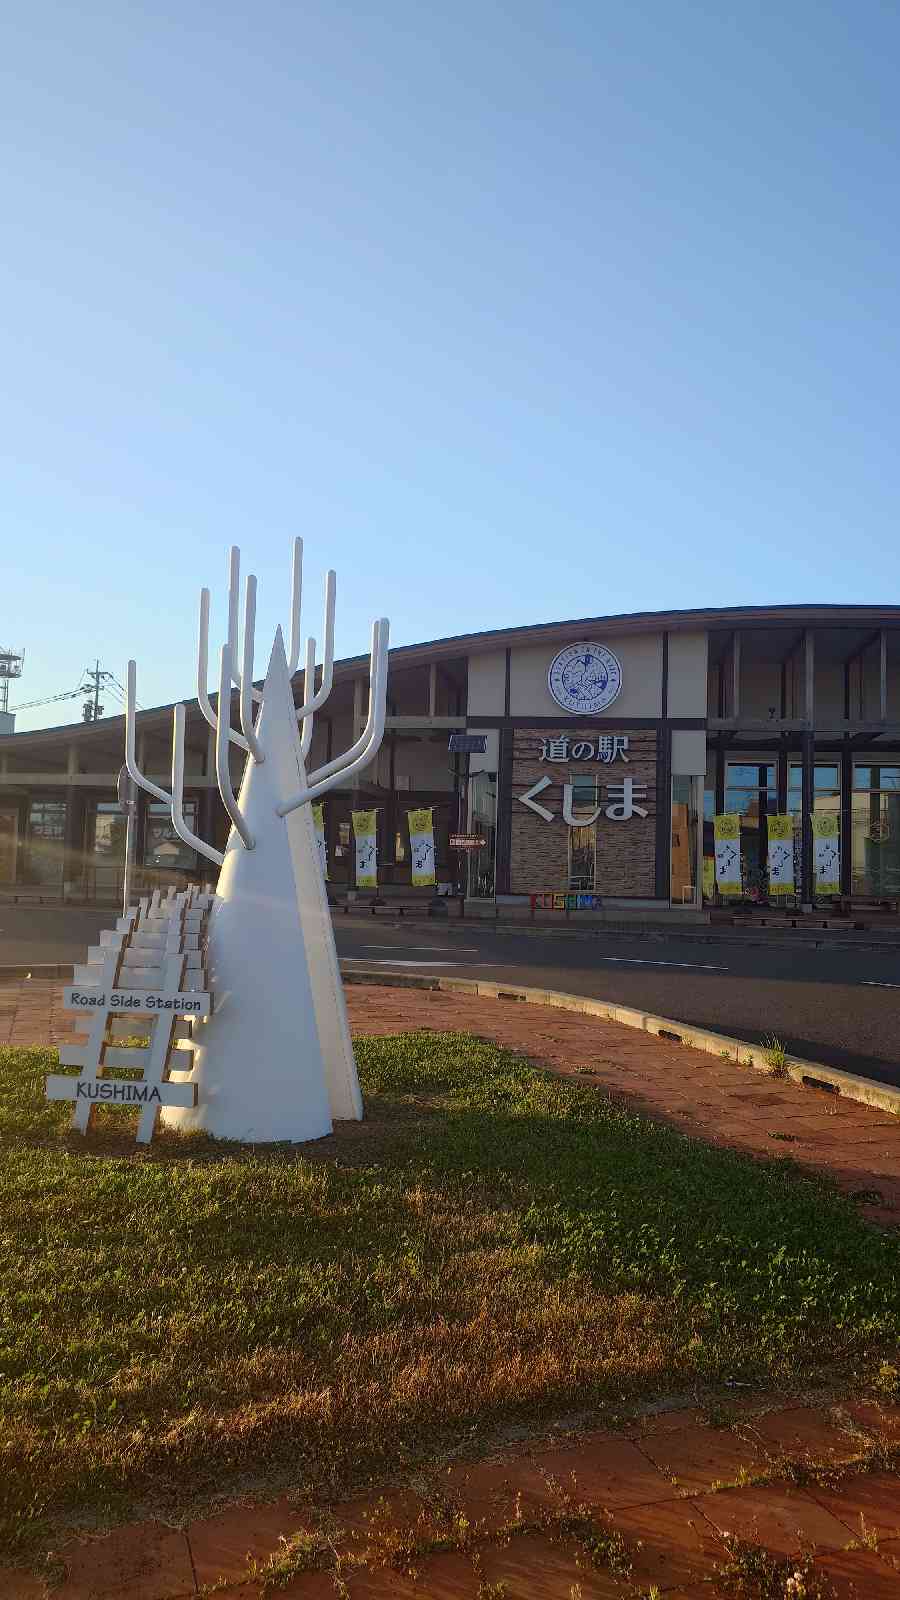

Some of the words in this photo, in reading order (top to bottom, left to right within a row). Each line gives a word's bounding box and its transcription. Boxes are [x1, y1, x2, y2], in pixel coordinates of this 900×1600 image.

[539, 735, 630, 763] 道の駅
[519, 775, 649, 826] くしま
[71, 992, 106, 1007] Road
[110, 994, 142, 1008] Side
[145, 996, 201, 1011] Station
[76, 1081, 162, 1103] KUSHIMA
